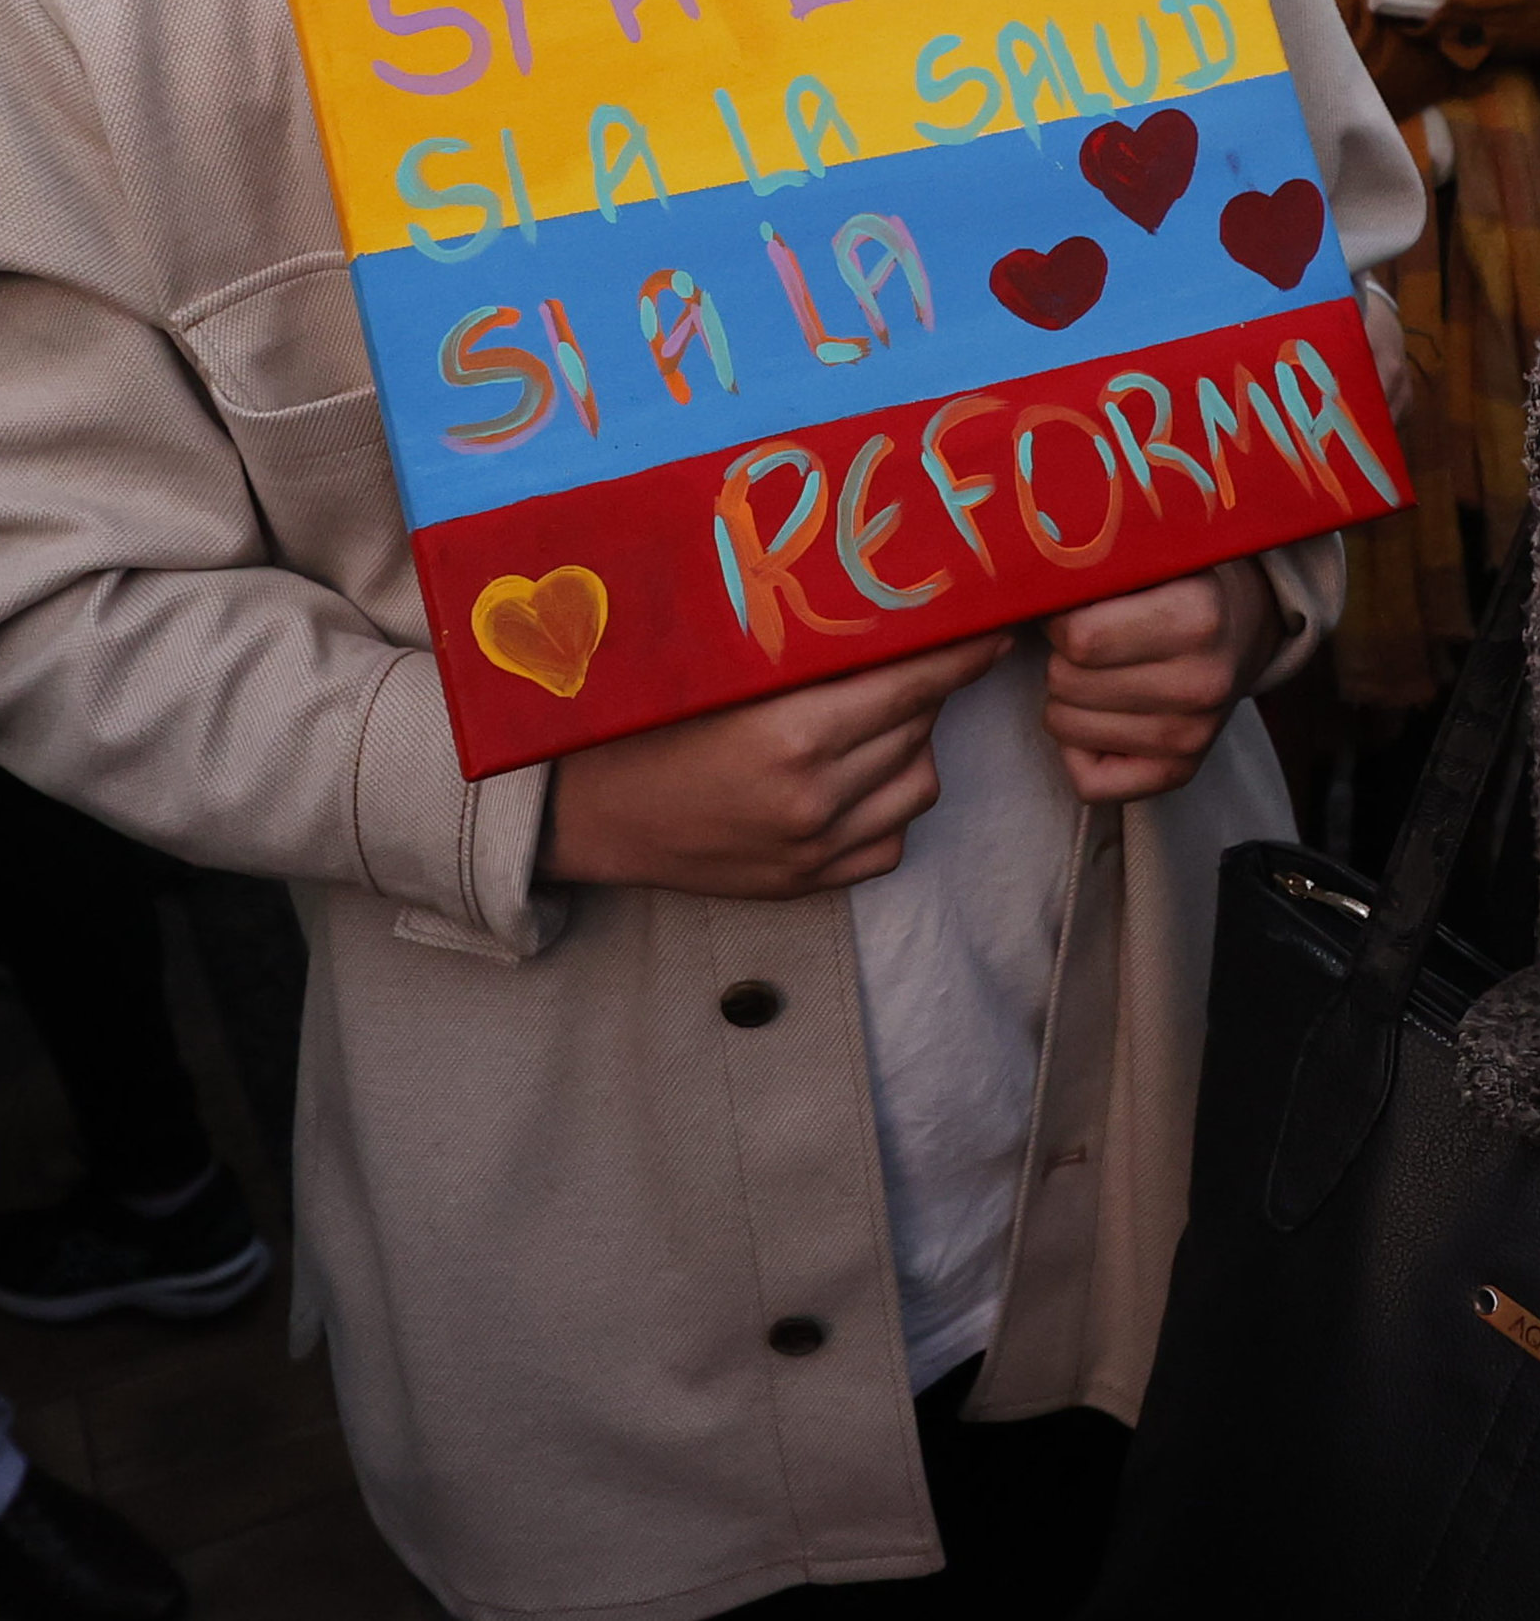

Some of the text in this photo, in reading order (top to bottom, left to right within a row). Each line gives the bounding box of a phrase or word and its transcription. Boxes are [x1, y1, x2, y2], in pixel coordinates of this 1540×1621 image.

[394, 129, 538, 263] SI
[587, 104, 669, 224] A
[714, 74, 860, 197] LA
[437, 213, 937, 454] SI A LA
[713, 336, 1403, 665] REFORMA
